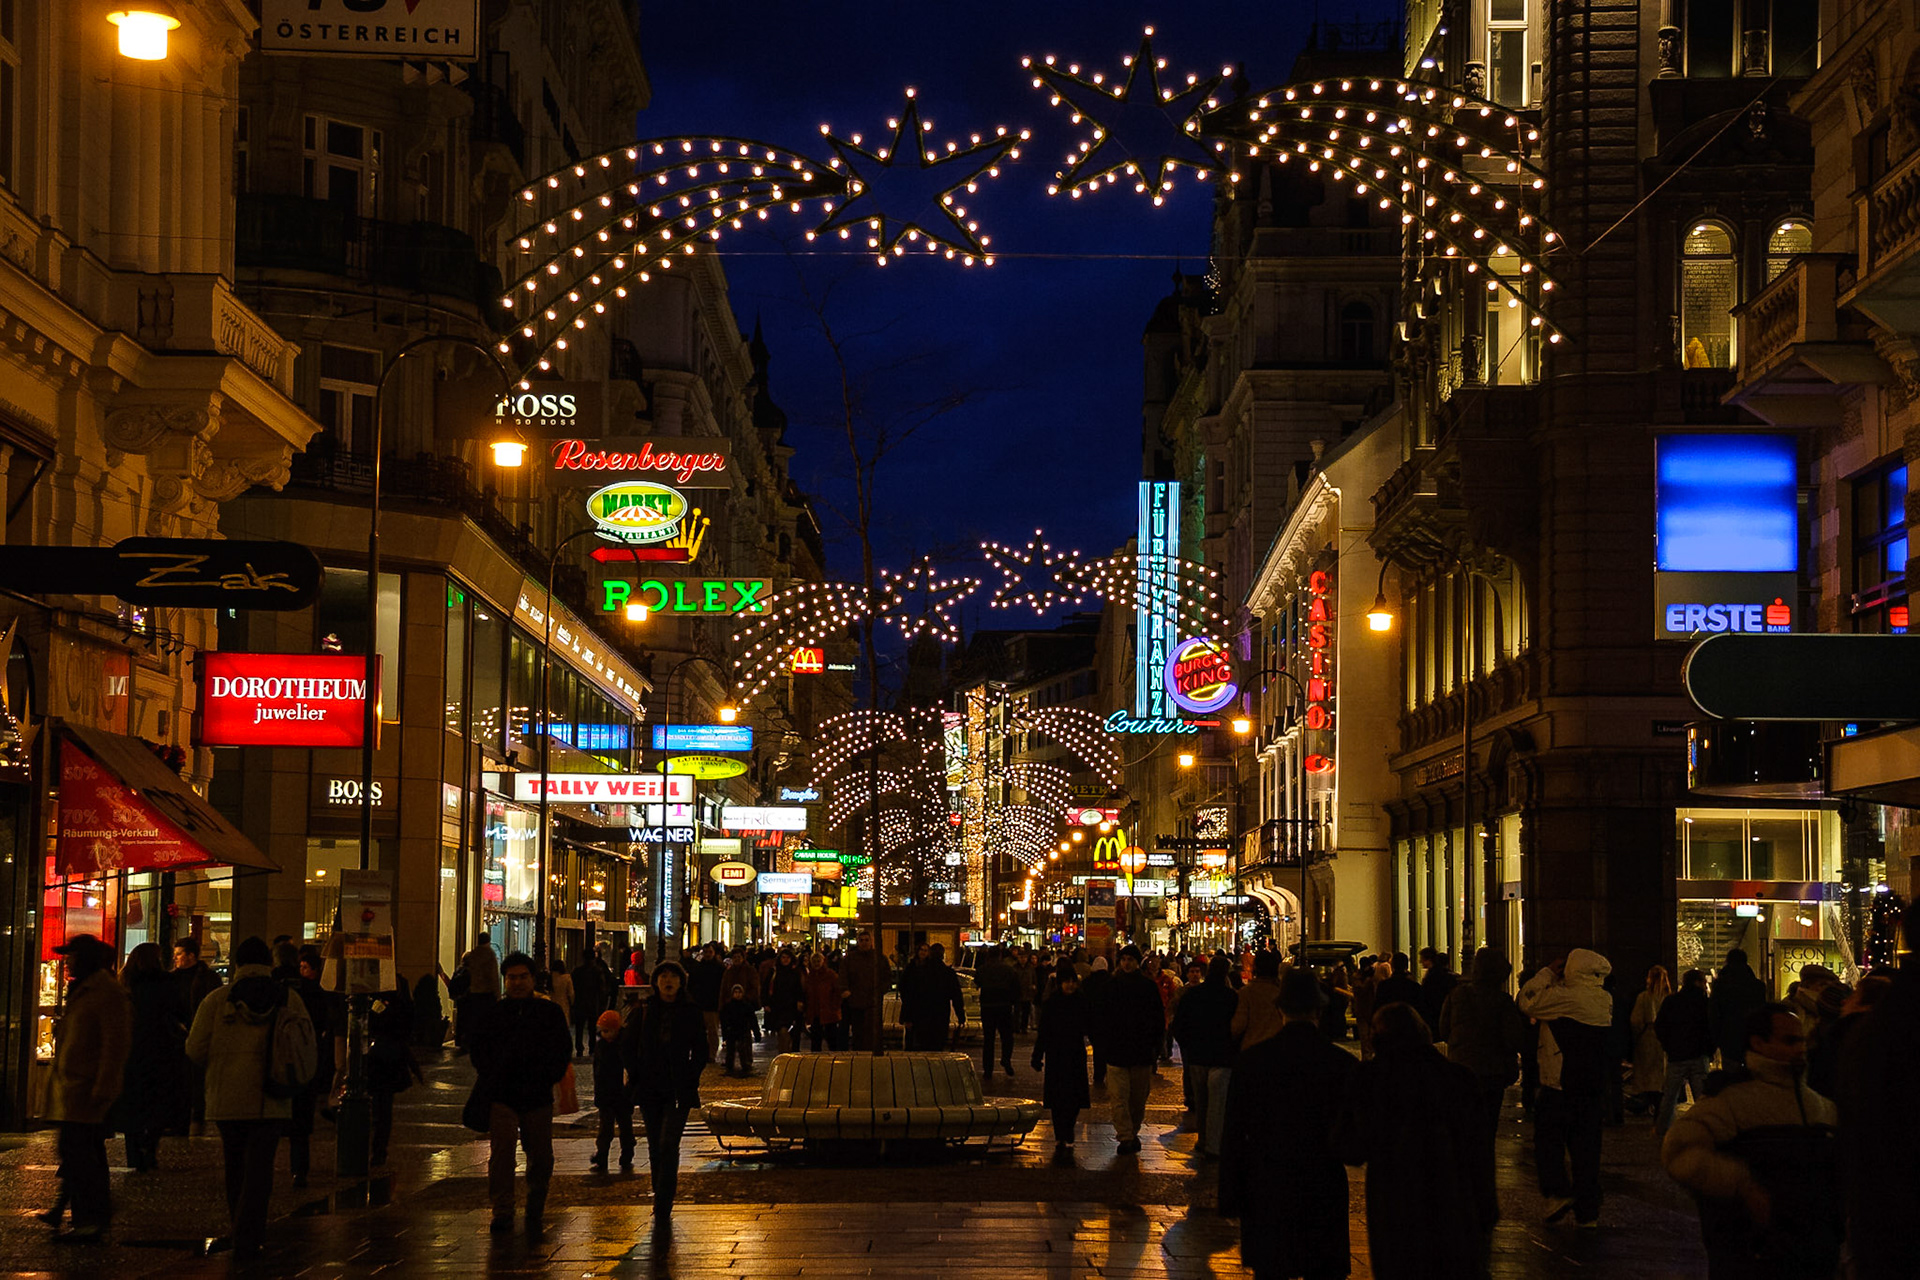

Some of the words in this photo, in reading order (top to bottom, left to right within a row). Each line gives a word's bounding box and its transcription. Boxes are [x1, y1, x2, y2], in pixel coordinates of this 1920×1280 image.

[277, 19, 460, 44] ÖSTERREICH
[552, 440, 726, 483] Rosenberger
[602, 494, 672, 518] MARKT
[601, 526, 675, 540] TAURANT
[119, 553, 300, 592] Zak
[602, 580, 763, 612] ROLEX
[1666, 604, 1763, 632] ERSTE
[1767, 625, 1791, 633] BANK
[1308, 570, 1332, 729] CASINO
[1174, 651, 1230, 678] BURGER
[1178, 666, 1231, 692] KING
[212, 676, 366, 700] DOROTHEUM
[254, 703, 327, 724] juwelier
[64, 767, 99, 780] 50%
[529, 780, 599, 795] TALLY
[62, 809, 99, 824] 70%
[113, 809, 147, 823] 50%
[63, 828, 159, 840] Räumungs-Verkauf
[629, 827, 694, 843] WAGNER
[153, 850, 181, 862] 30%
[724, 870, 743, 878] EMI
[1121, 880, 1159, 889] TRDI'S
[1783, 947, 1827, 960] EGON
